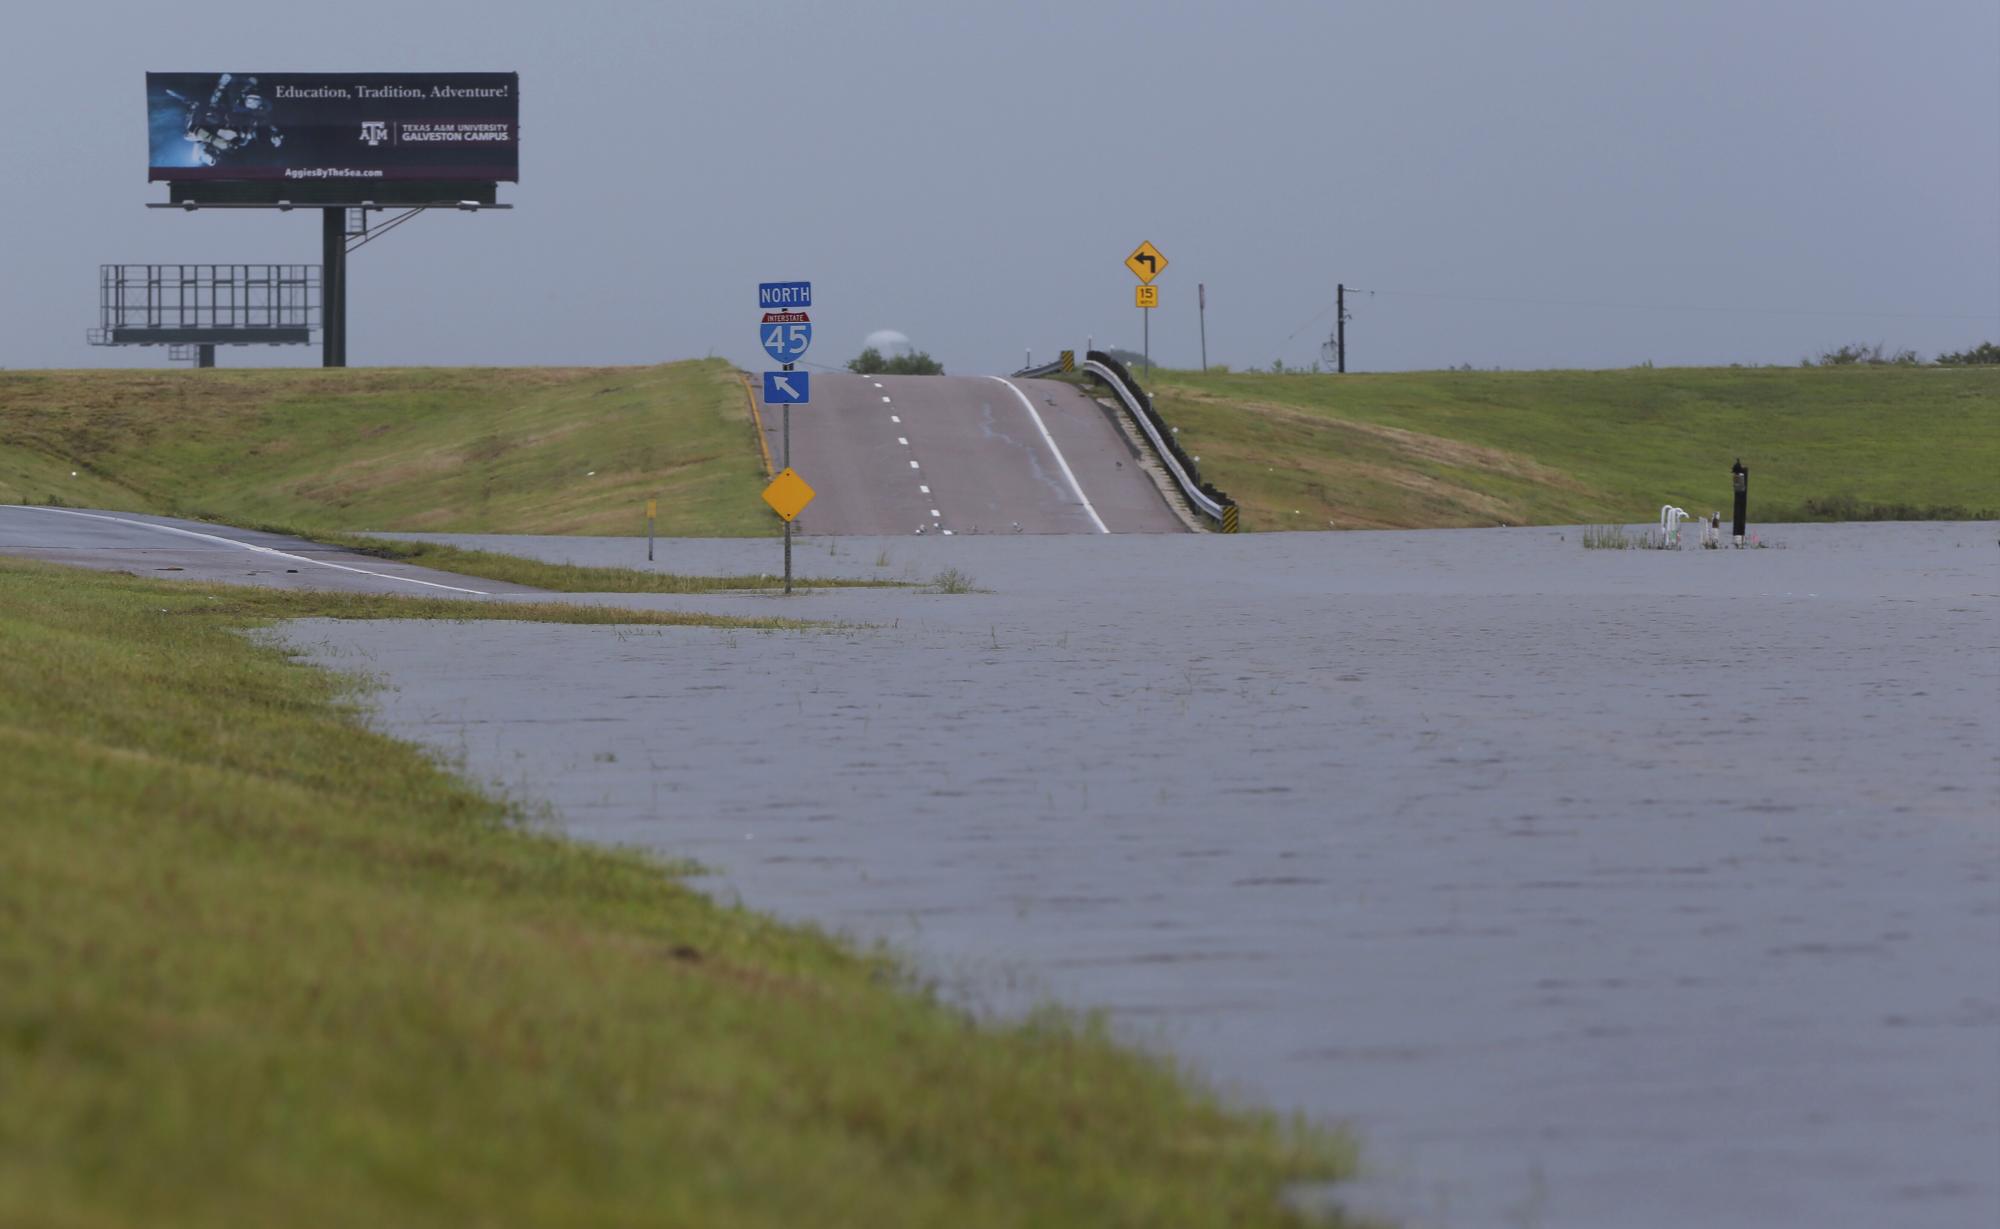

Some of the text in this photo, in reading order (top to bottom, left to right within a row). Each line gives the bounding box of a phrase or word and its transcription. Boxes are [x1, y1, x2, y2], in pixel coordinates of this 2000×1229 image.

[276, 85, 508, 99] Education, Tradition, Adventure!
[402, 124, 509, 132] TEXAS A&M UNIVERSITY
[402, 132, 508, 141] GALVESTON CAMPUS
[285, 168, 383, 178] AggiesByTheSea.com
[761, 287, 810, 303] NORTH
[1140, 287, 1153, 298] 15
[768, 314, 804, 322] INTERSTATE
[765, 325, 808, 354] 45
